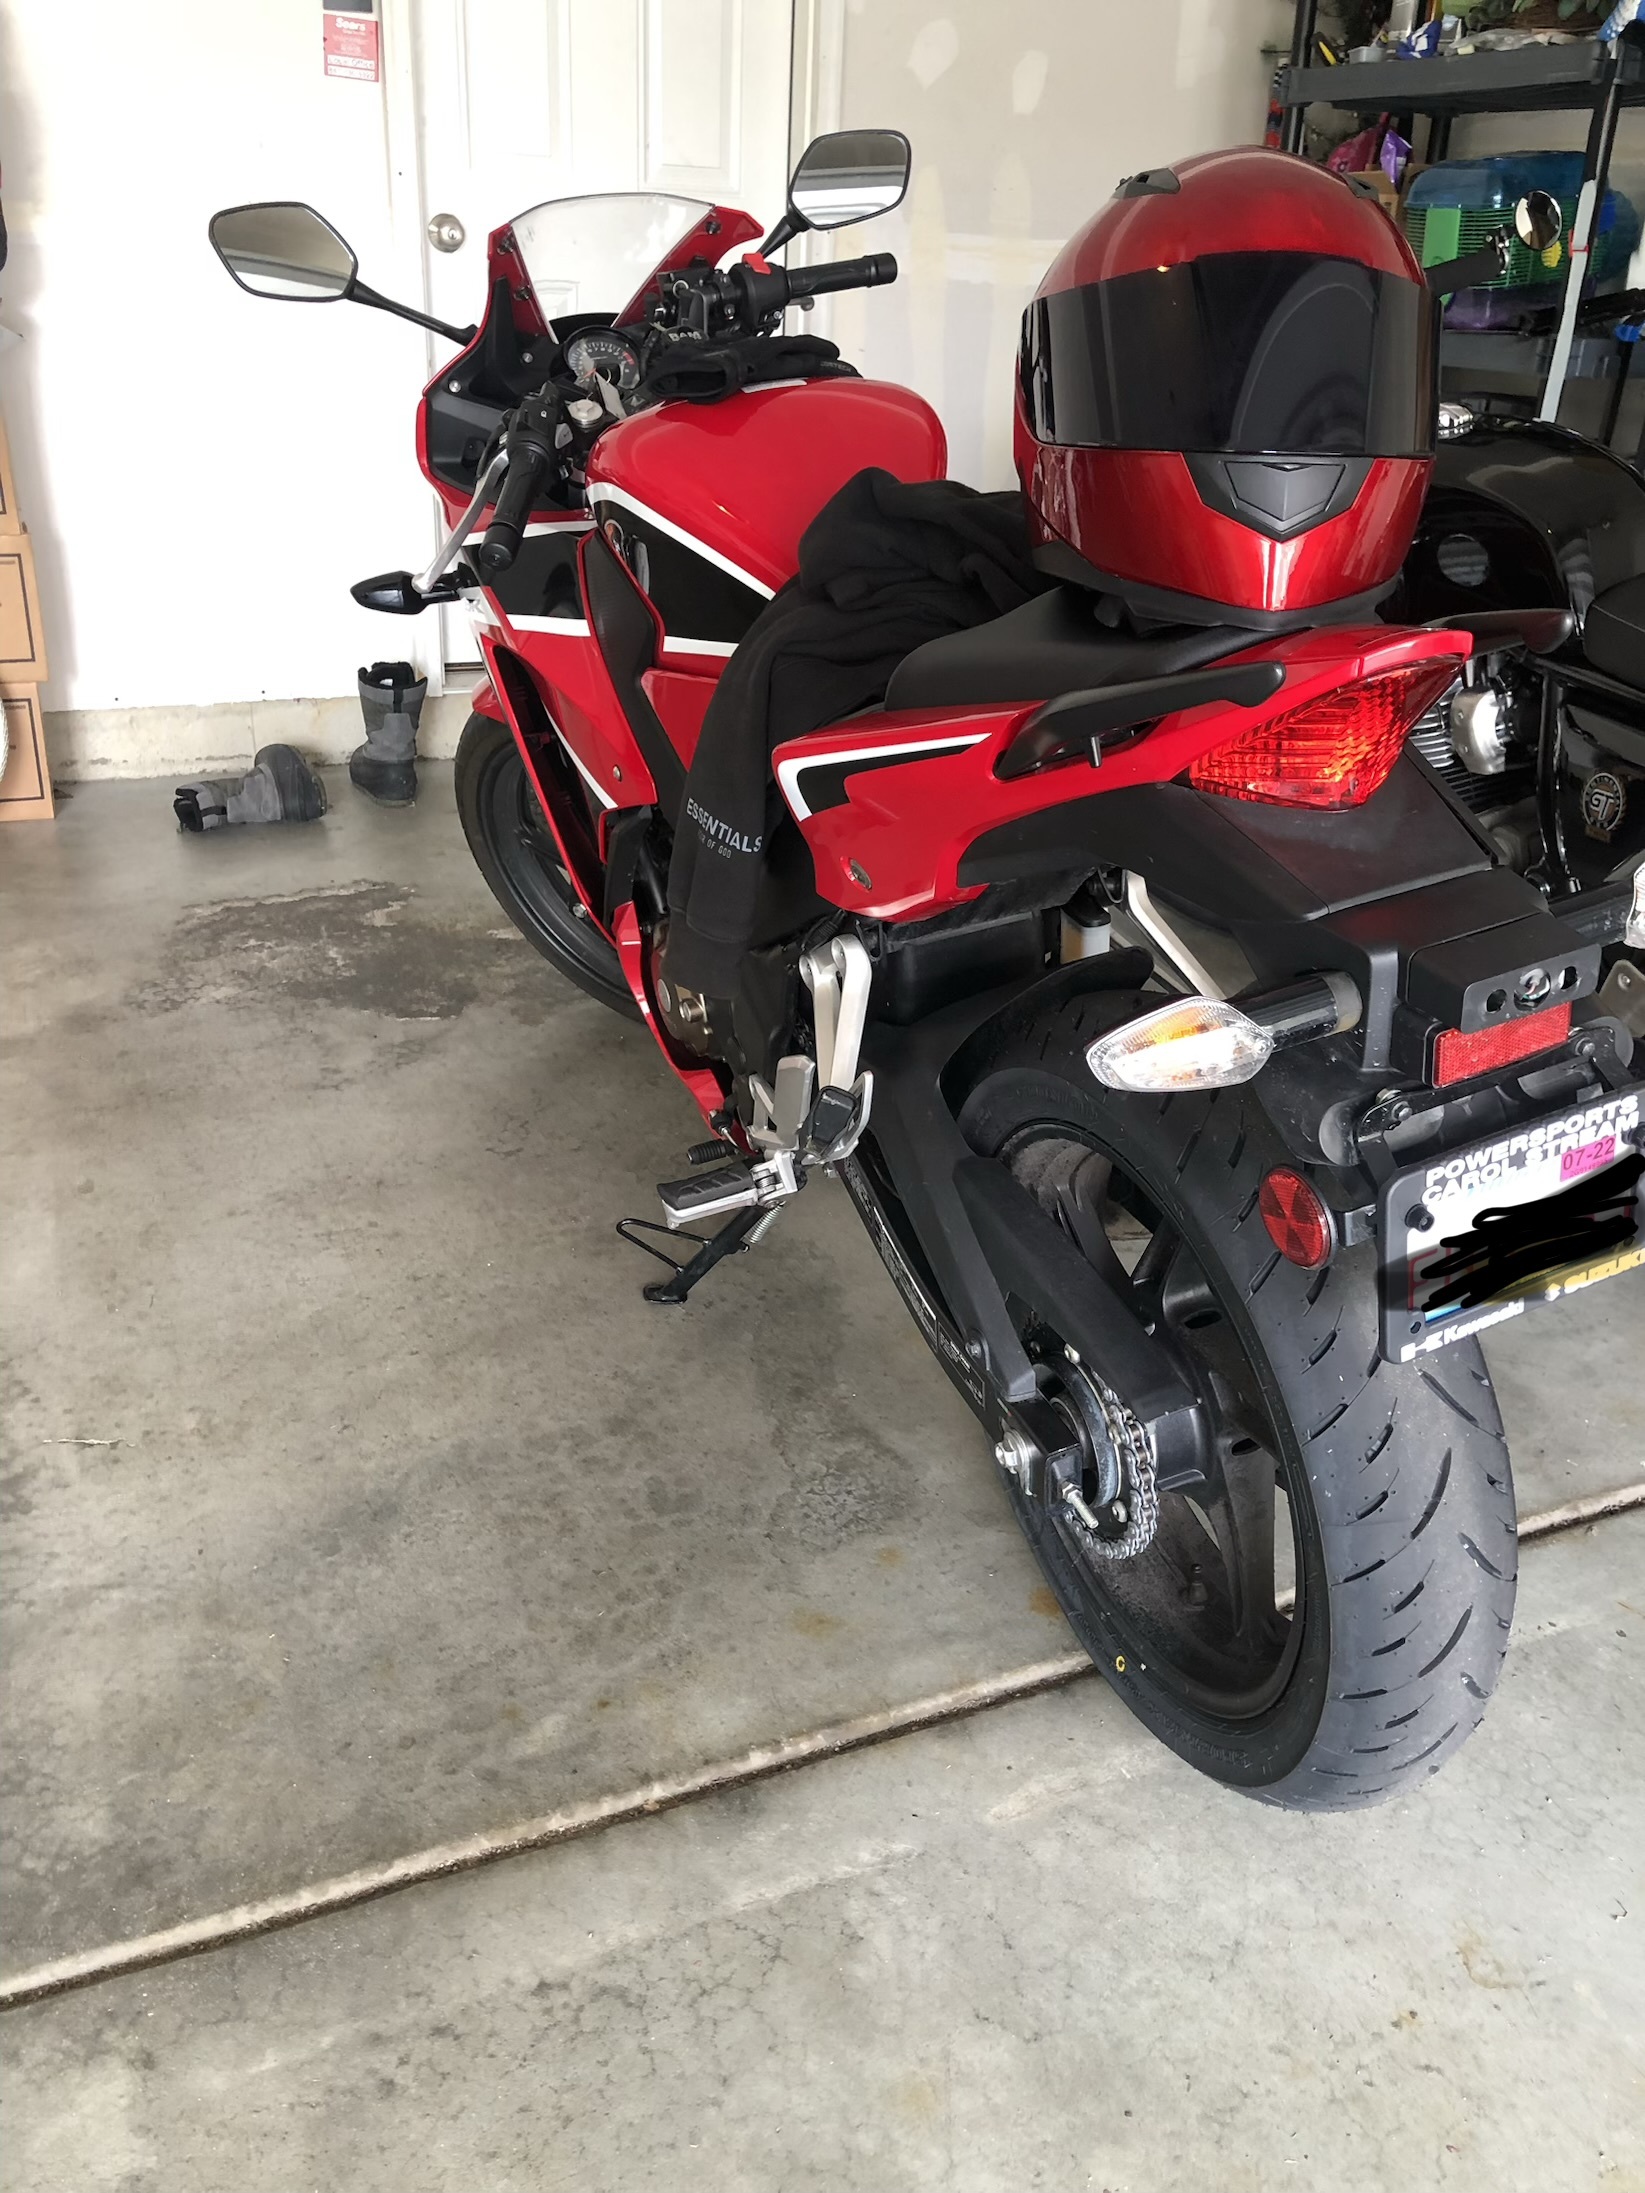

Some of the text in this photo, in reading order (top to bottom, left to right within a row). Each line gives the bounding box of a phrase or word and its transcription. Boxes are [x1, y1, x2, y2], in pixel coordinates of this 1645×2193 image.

[335, 17, 366, 31] Sears
[686, 797, 763, 853] ESSENTIALS
[706, 838, 732, 859] OF GOD
[1421, 1158, 1518, 1206] CAROL
[1525, 1111, 1641, 1166] STREAM
[1425, 1095, 1639, 1189] POWERSPORTS
[1563, 1137, 1615, 1172] 07-22
